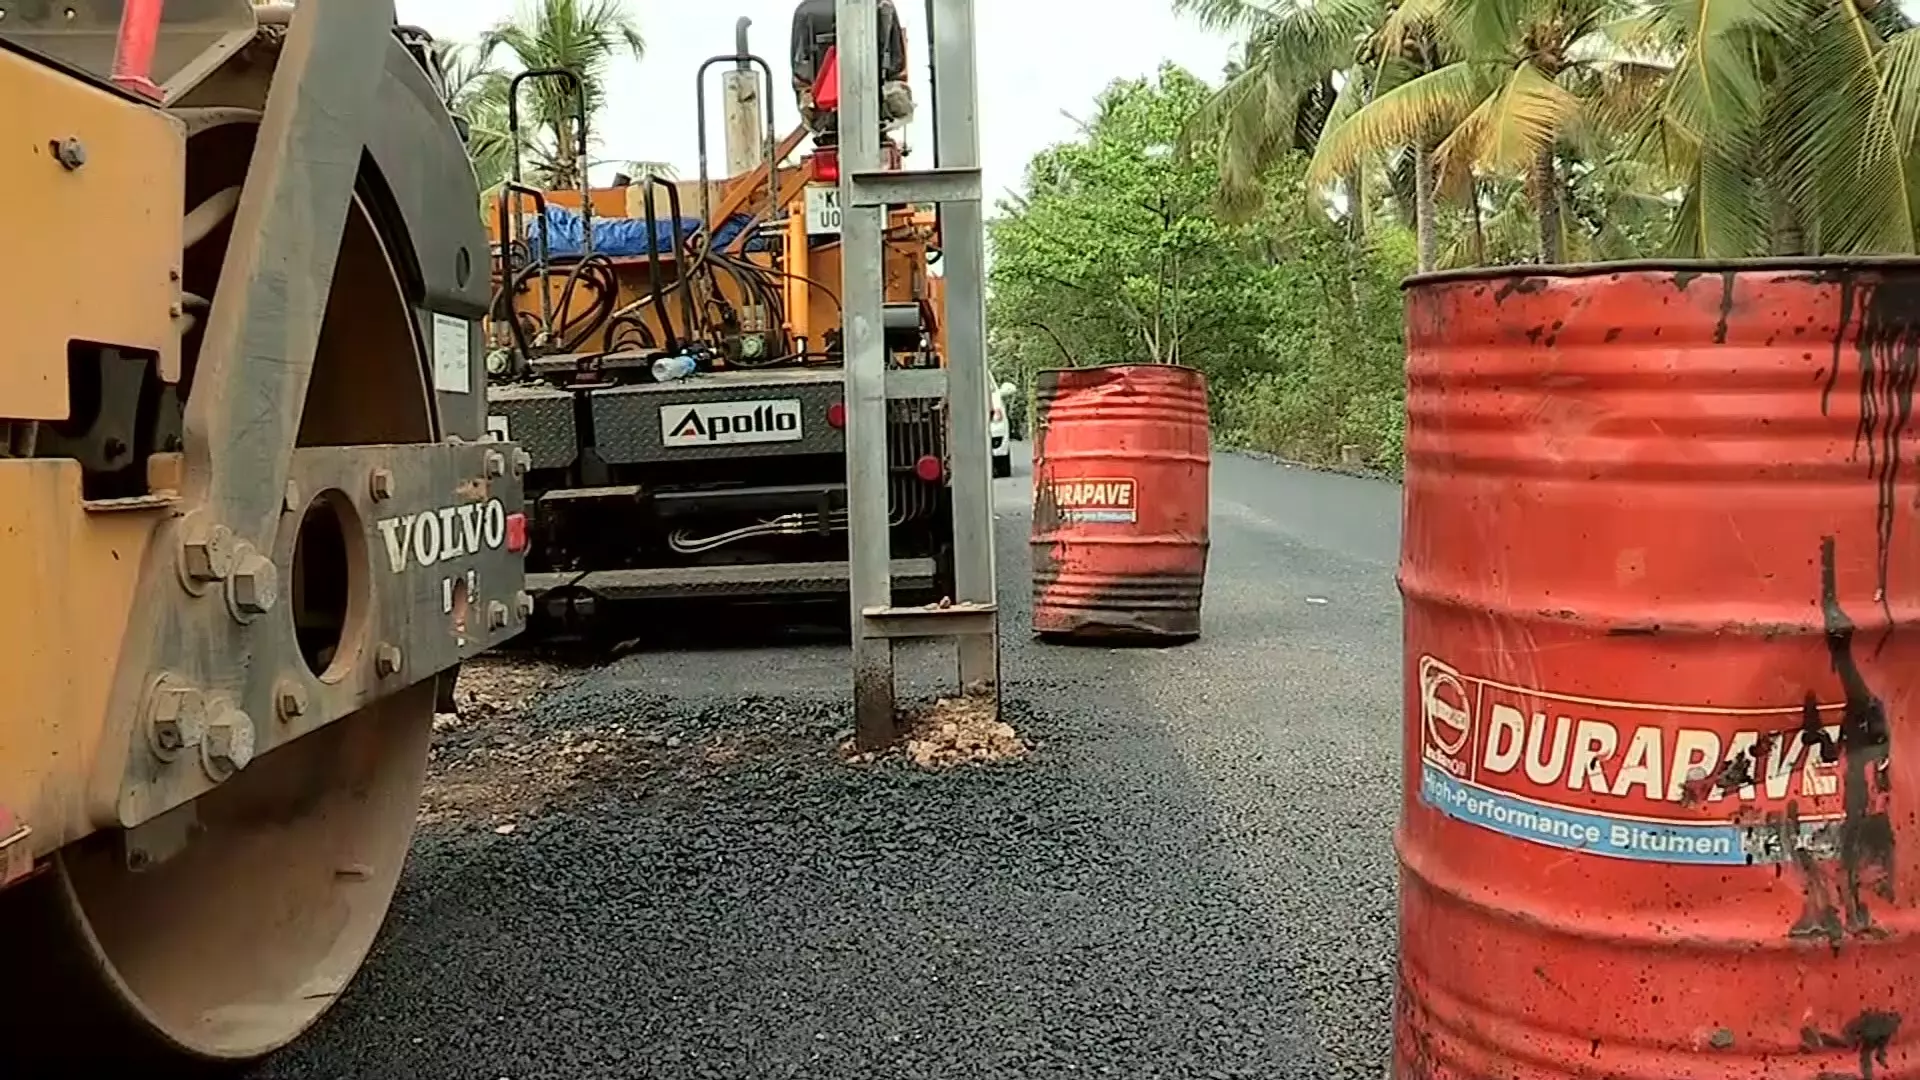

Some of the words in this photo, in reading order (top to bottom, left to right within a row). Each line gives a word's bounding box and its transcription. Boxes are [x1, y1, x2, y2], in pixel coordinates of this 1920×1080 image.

[669, 404, 797, 441] Apollo
[1054, 483, 1132, 506] URAPAVE
[377, 498, 505, 574] VOLVO
[1483, 703, 1843, 803] DURAPAVE
[1424, 770, 1601, 843] High-Performance
[1609, 824, 1731, 854] Bitumen
